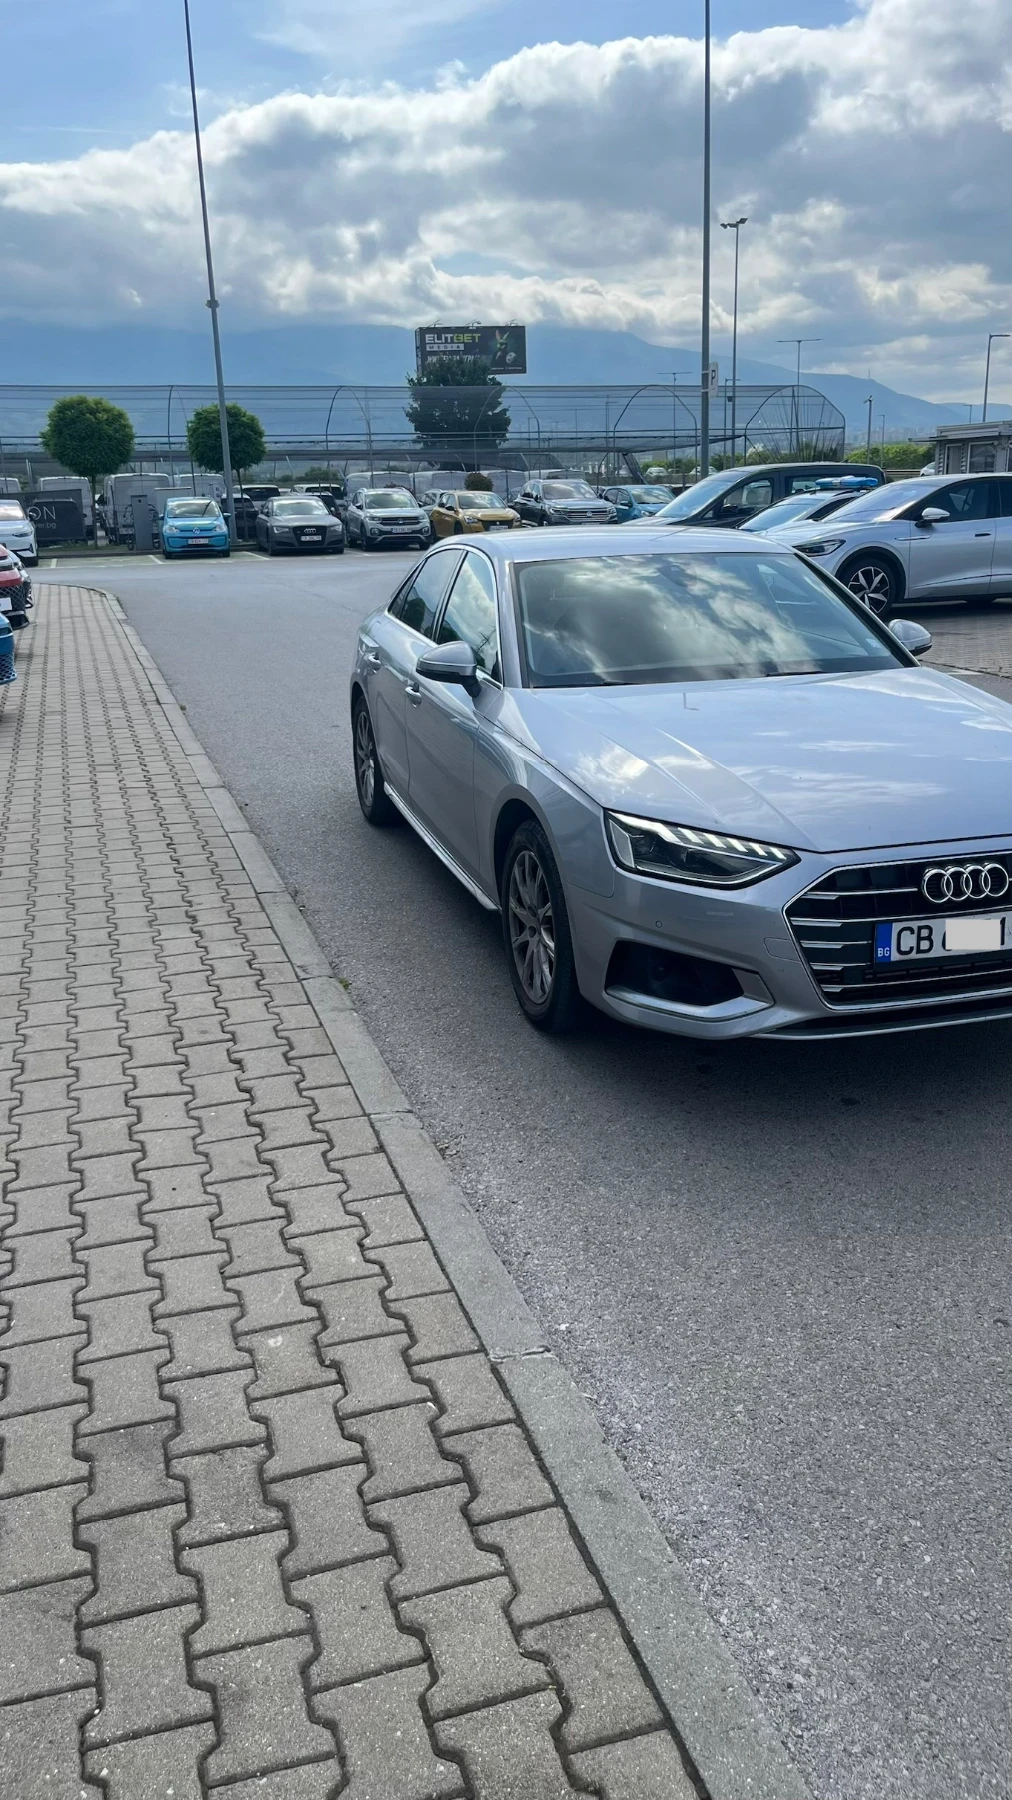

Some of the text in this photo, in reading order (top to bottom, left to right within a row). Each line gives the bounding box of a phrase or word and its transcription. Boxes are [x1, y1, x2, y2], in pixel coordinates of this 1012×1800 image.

[425, 333, 481, 343] ELITBET
[710, 369, 717, 386] P
[896, 924, 934, 956] CB
[877, 947, 890, 957] BG
